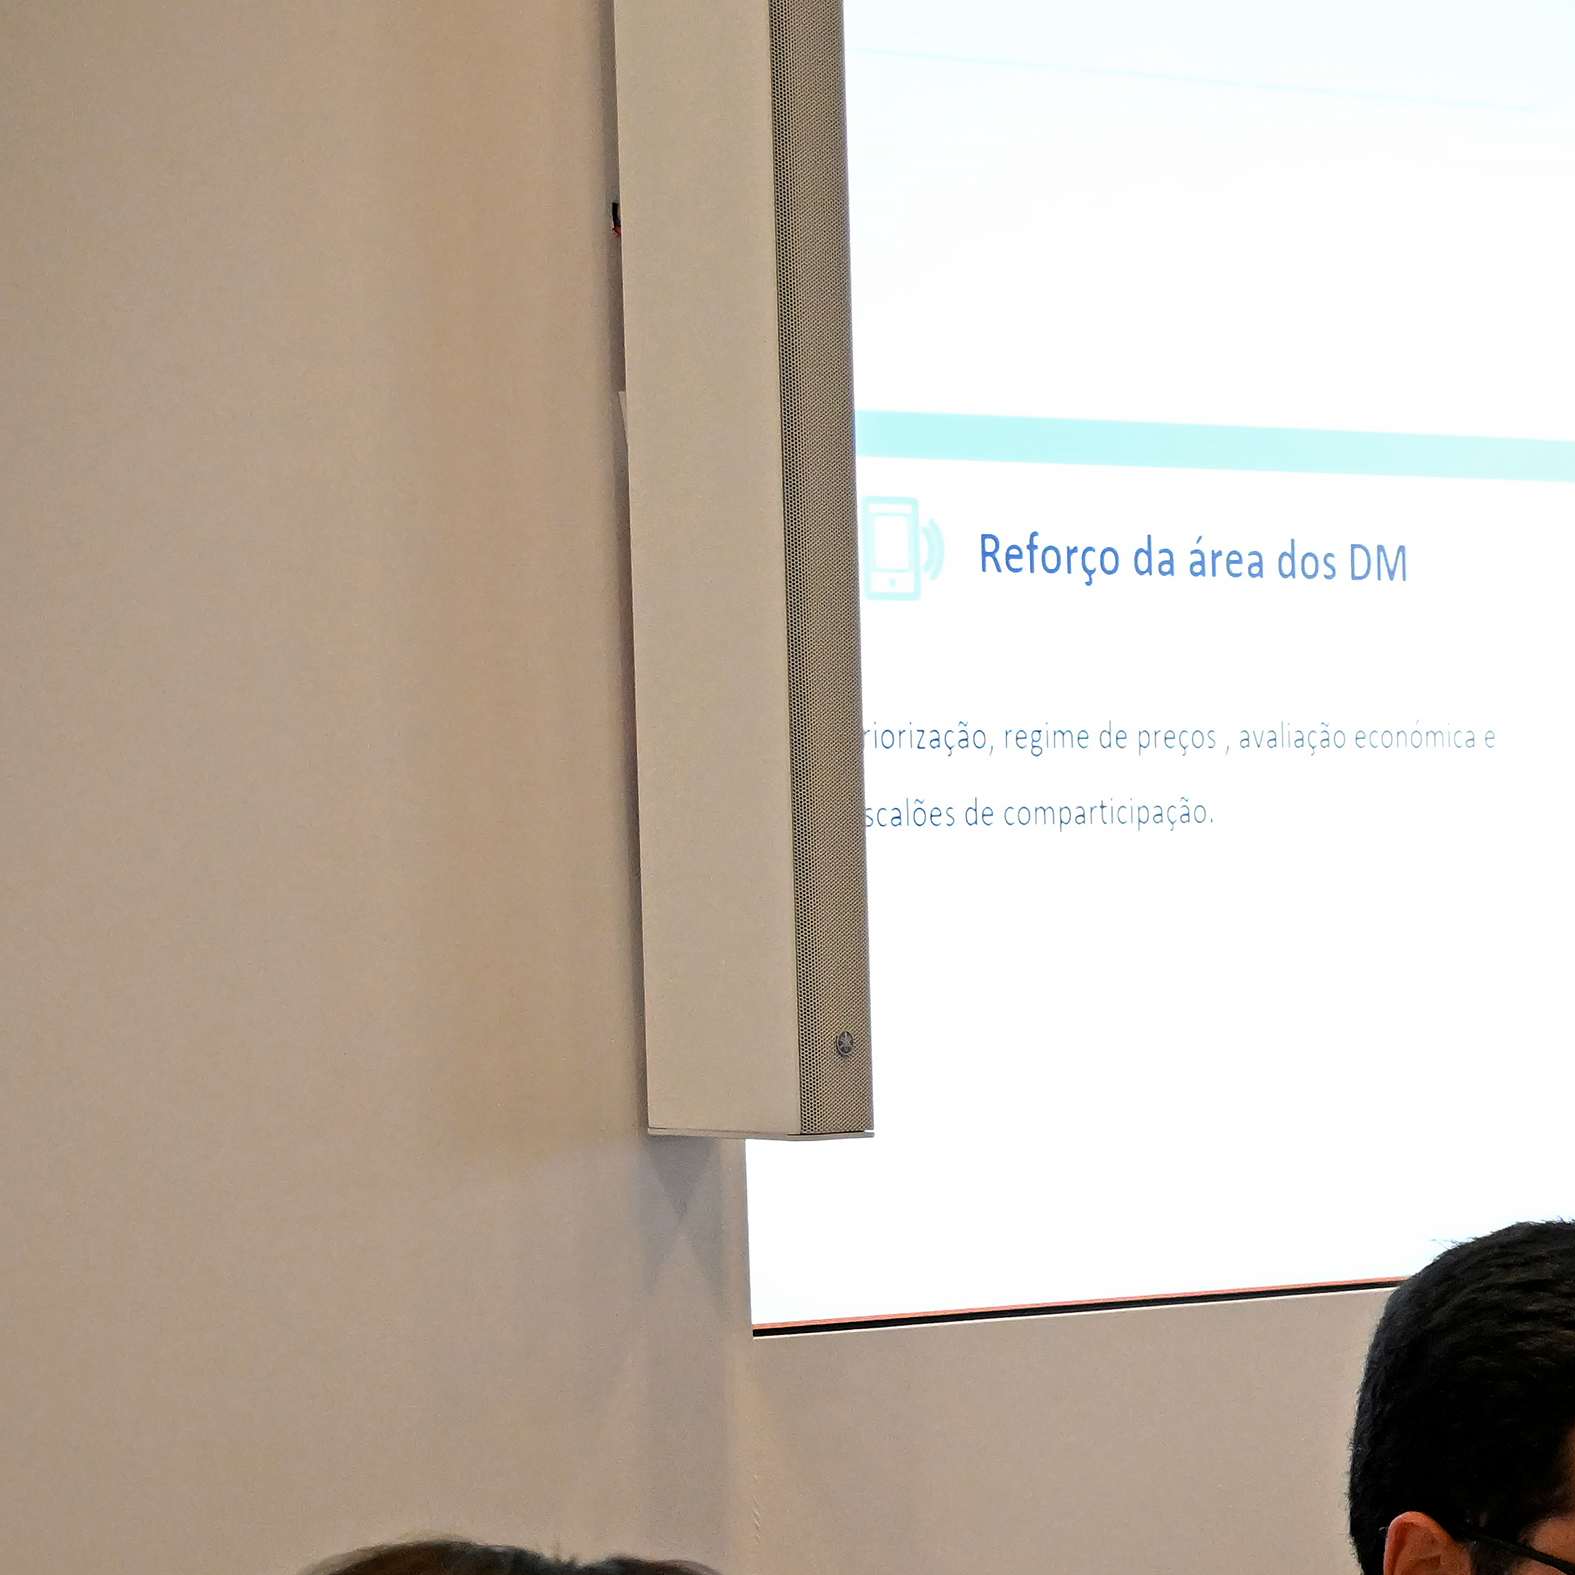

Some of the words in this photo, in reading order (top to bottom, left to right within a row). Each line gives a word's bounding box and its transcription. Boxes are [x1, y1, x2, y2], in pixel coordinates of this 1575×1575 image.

[979, 531, 1121, 587] Reforço
[1133, 534, 1176, 578] da
[1187, 536, 1265, 580] área
[1277, 538, 1337, 581] dos
[1349, 543, 1408, 582] DM
[1004, 721, 1090, 758] regime
[1099, 720, 1128, 749] de
[1137, 728, 1217, 758] preços
[1239, 720, 1347, 757] avaliação
[1354, 719, 1477, 749] económica
[1484, 728, 1497, 750] e
[964, 796, 994, 827] de
[1003, 797, 1215, 832] comparticipação.
